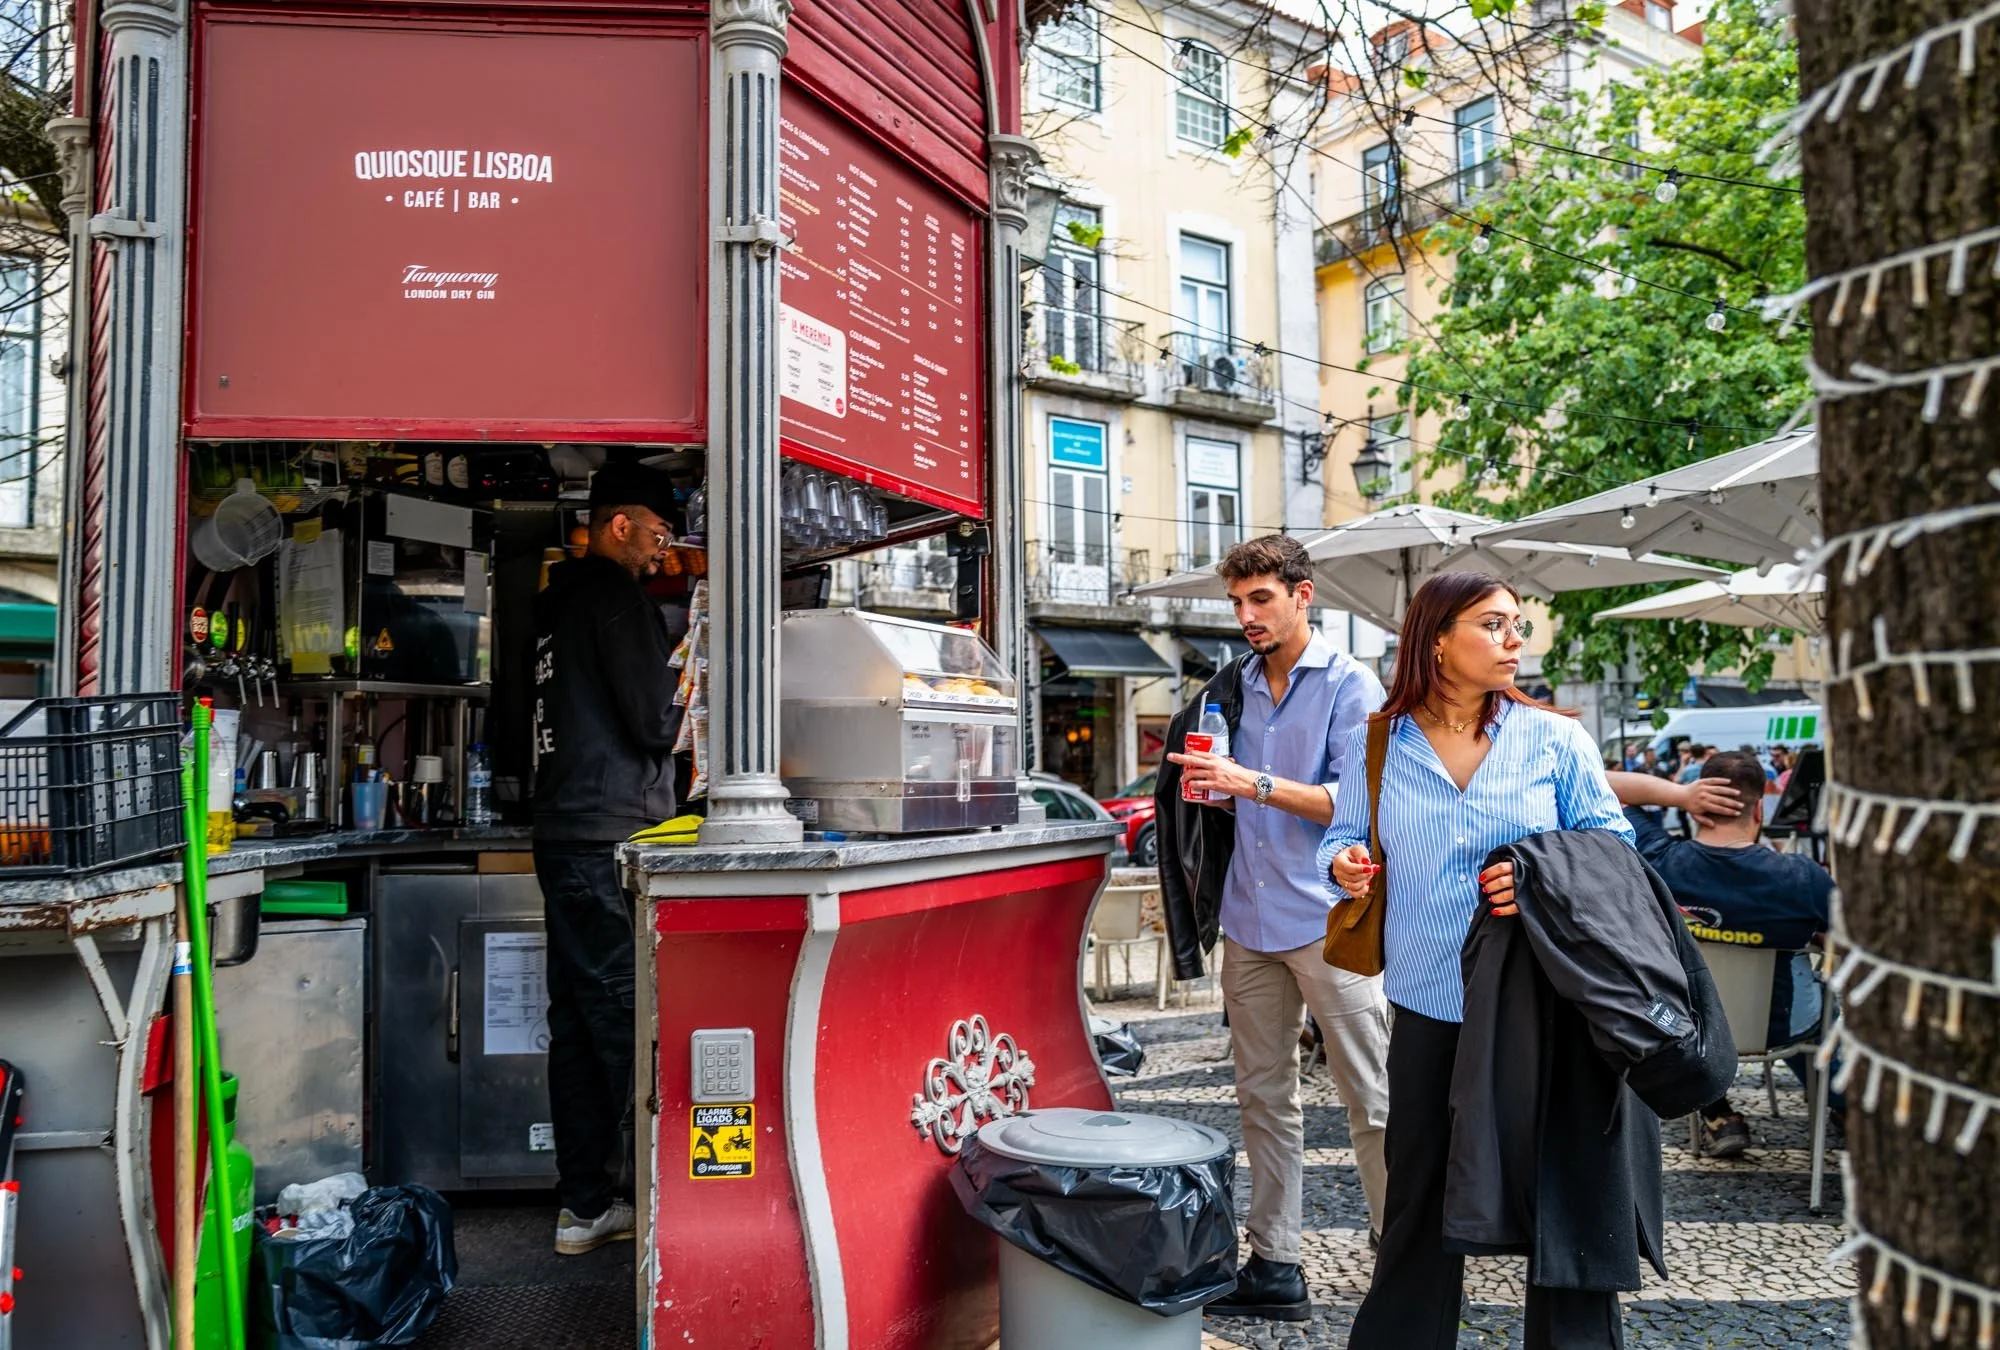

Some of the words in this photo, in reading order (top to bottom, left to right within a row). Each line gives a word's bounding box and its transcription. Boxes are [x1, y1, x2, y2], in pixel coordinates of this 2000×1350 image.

[355, 150, 468, 180] QUIOSQUE
[473, 151, 553, 183] LISBOA
[404, 188, 445, 208] CAFÉ
[468, 192, 500, 209] BAR
[402, 265, 499, 289] Tanqueray
[405, 290, 447, 299] LONDON
[451, 290, 472, 299] DRY
[477, 291, 495, 300] GIN
[696, 1115, 733, 1123] LIGADO
[698, 1108, 733, 1116] ALARME
